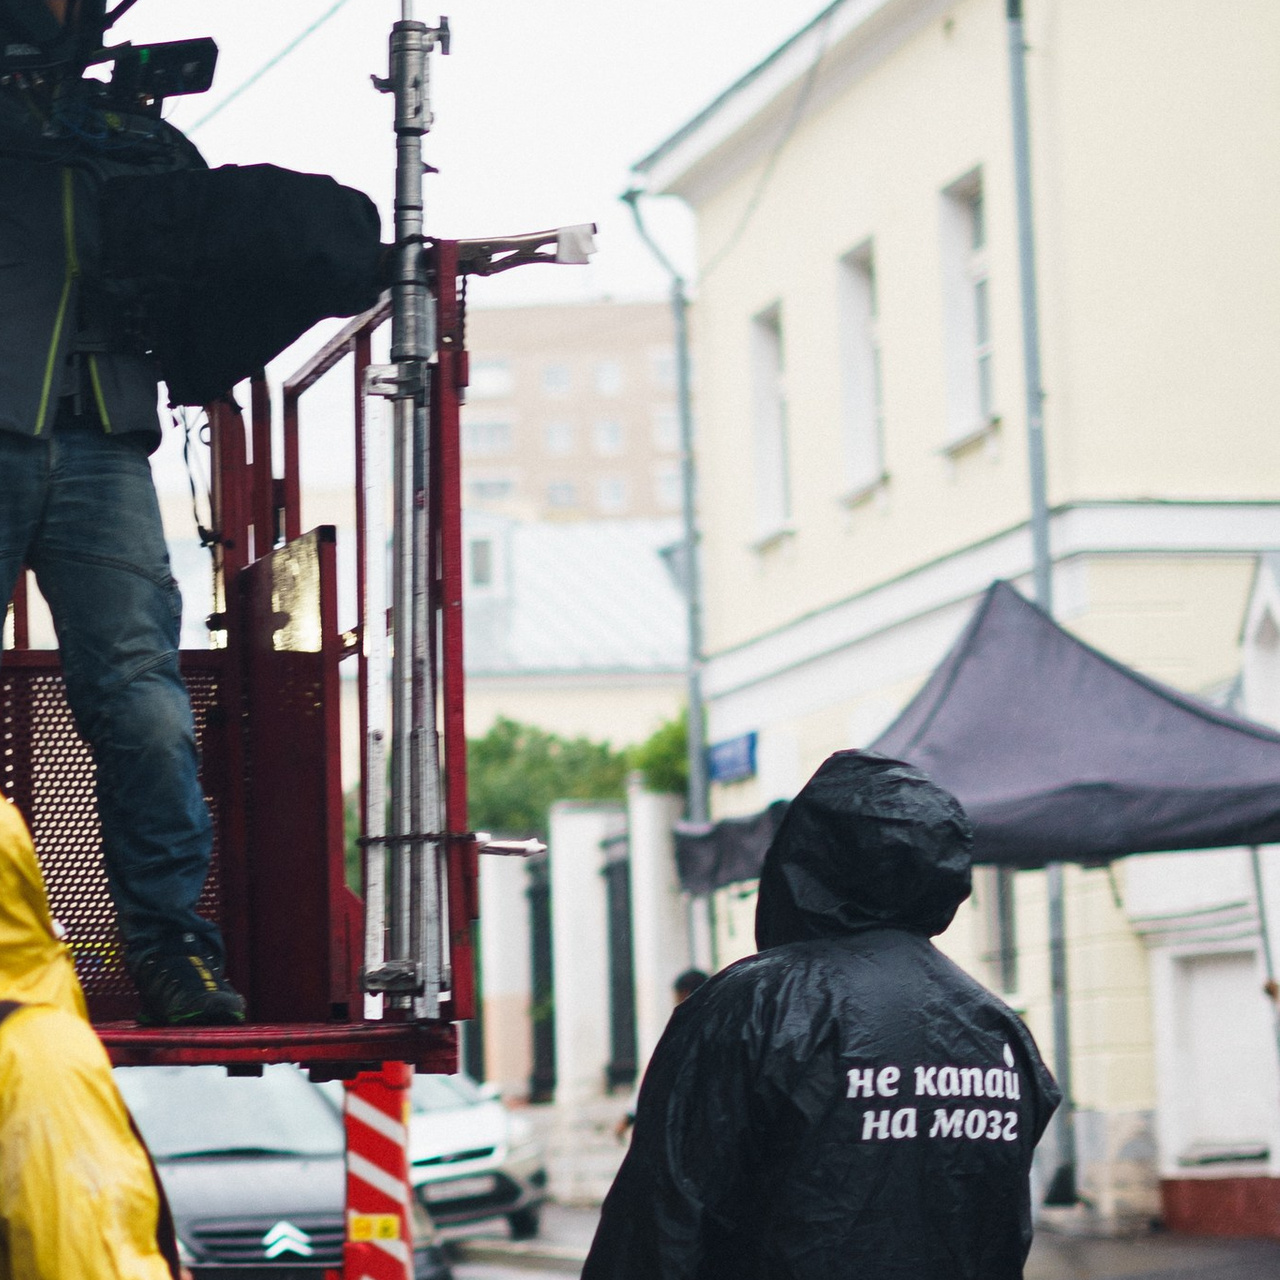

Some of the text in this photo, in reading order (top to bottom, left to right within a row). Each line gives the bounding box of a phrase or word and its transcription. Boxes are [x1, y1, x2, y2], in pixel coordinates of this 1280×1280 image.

[846, 1043, 1021, 1101] не капай
[861, 1107, 1018, 1142] на мозг
